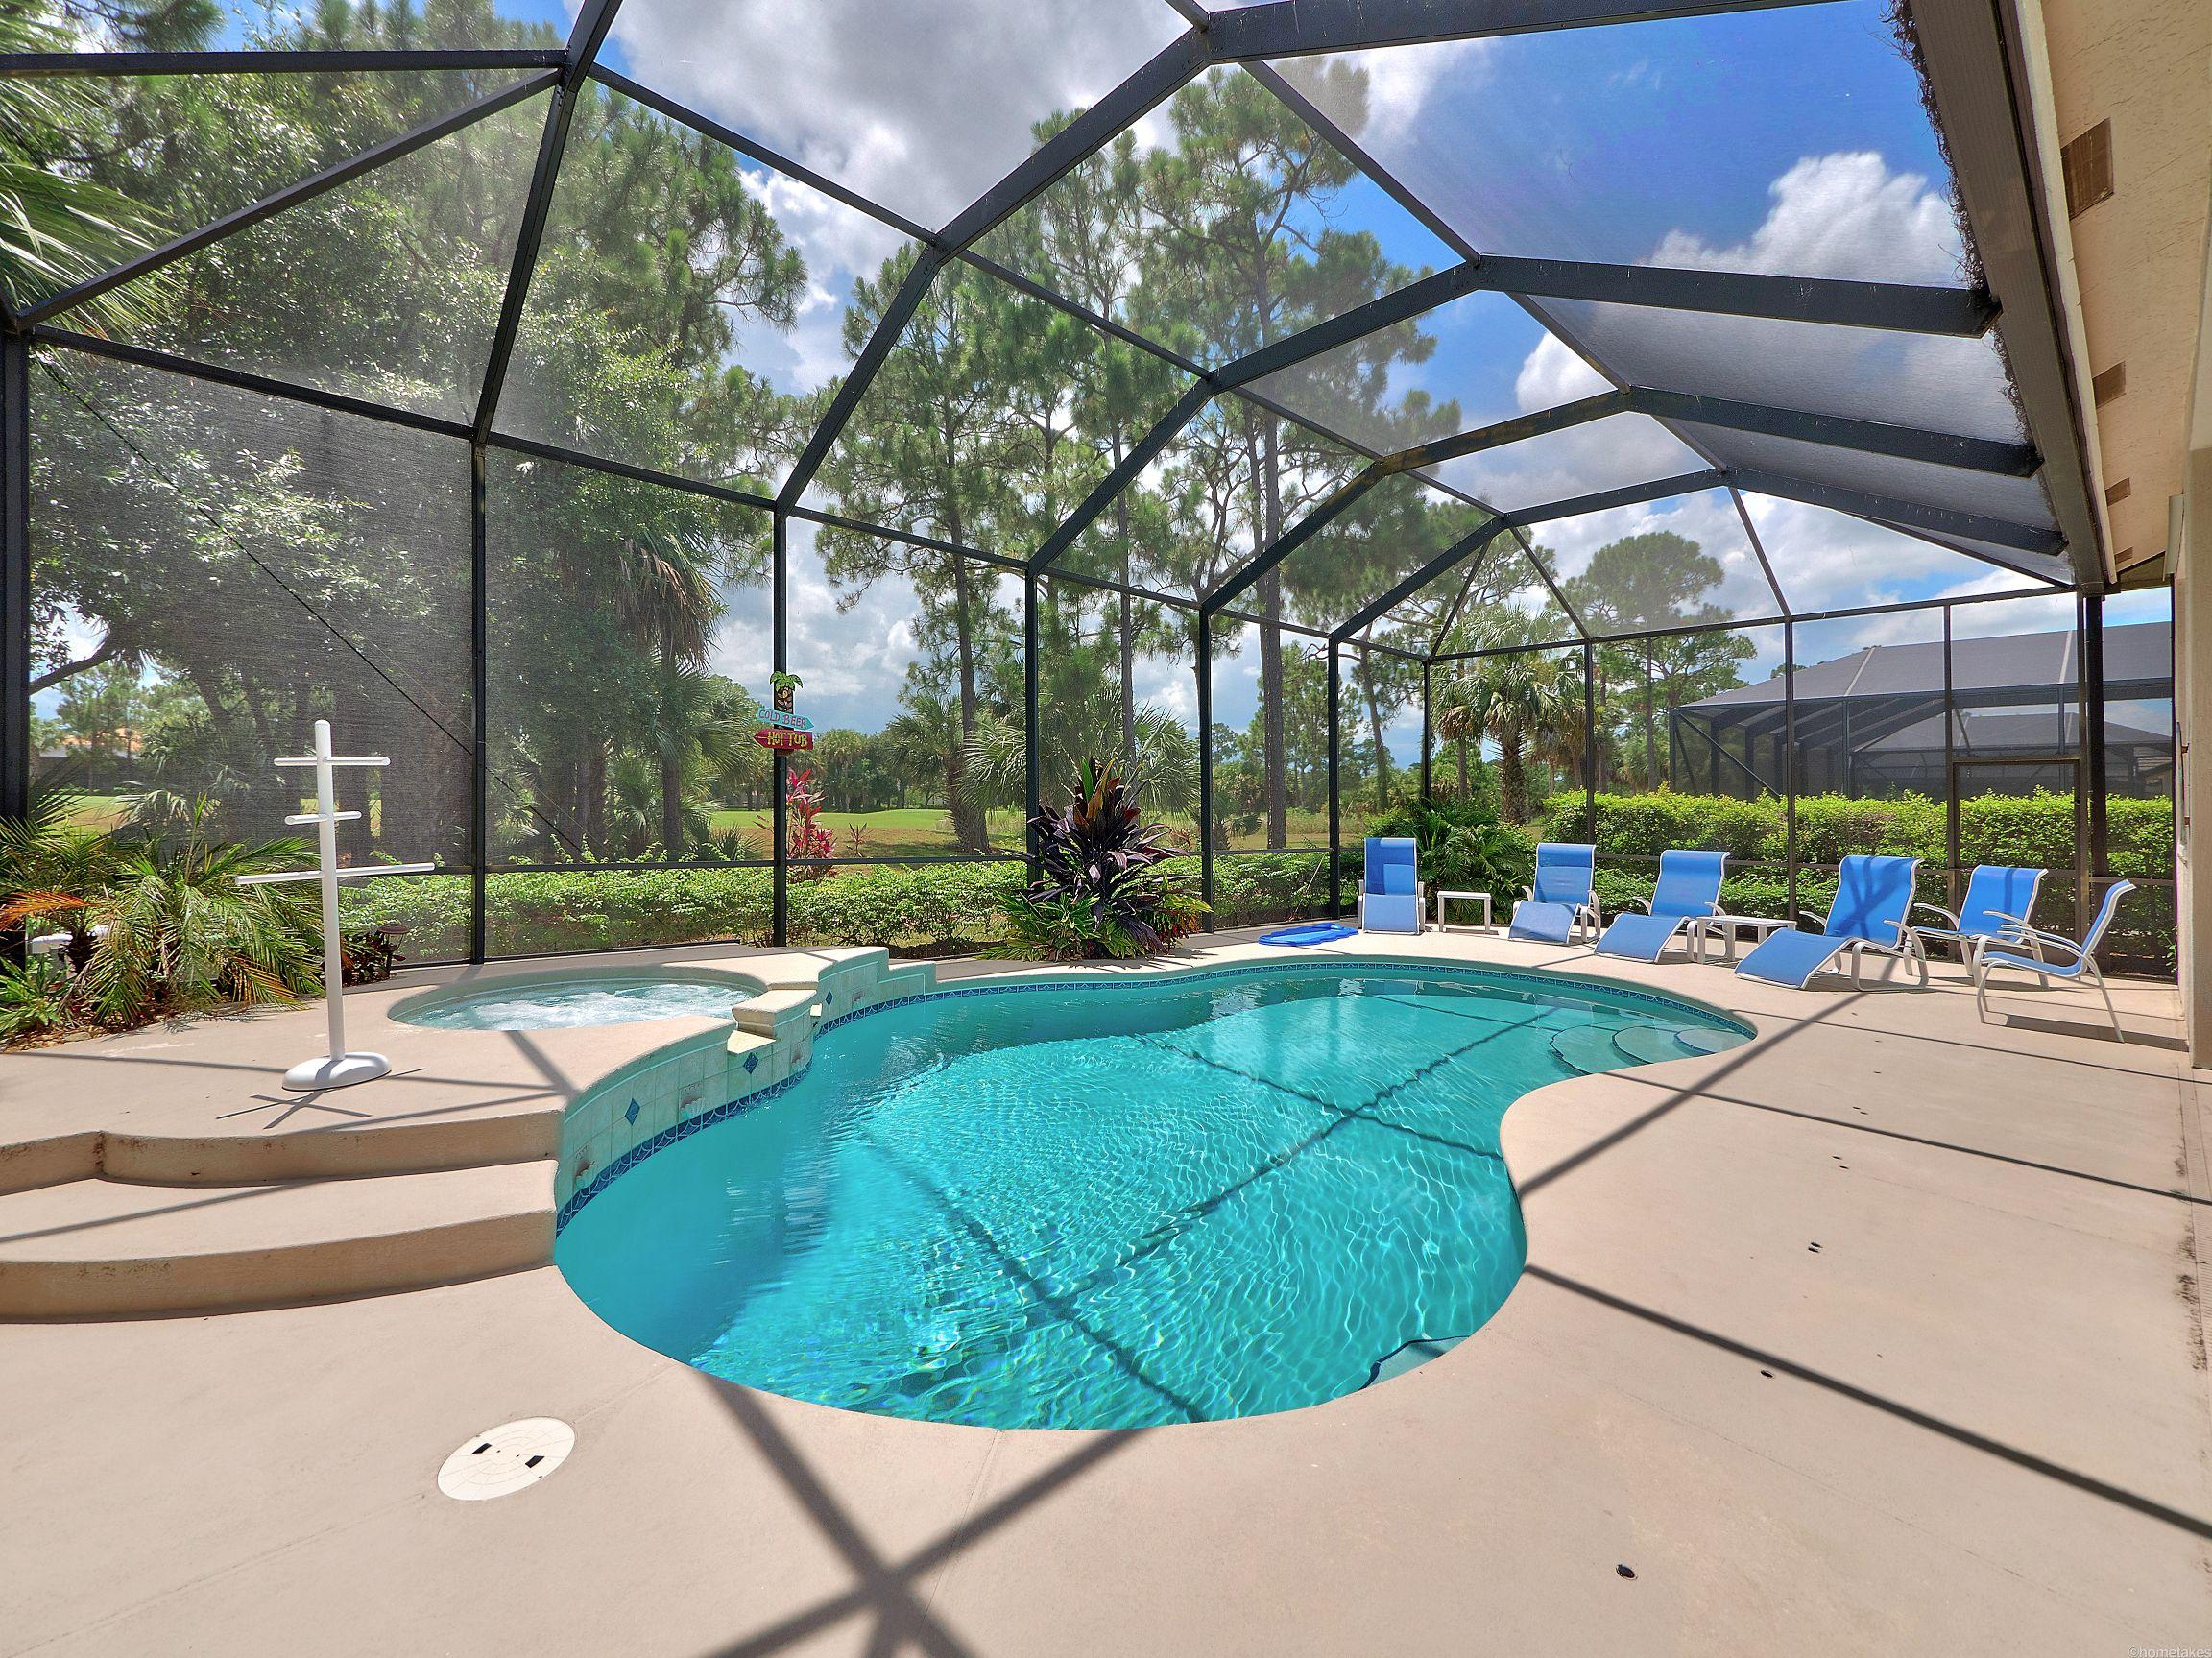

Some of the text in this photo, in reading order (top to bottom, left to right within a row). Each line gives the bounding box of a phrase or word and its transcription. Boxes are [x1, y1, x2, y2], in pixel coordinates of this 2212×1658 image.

[758, 709, 806, 728] COLD BEER
[767, 732, 807, 747] HOT TUB
